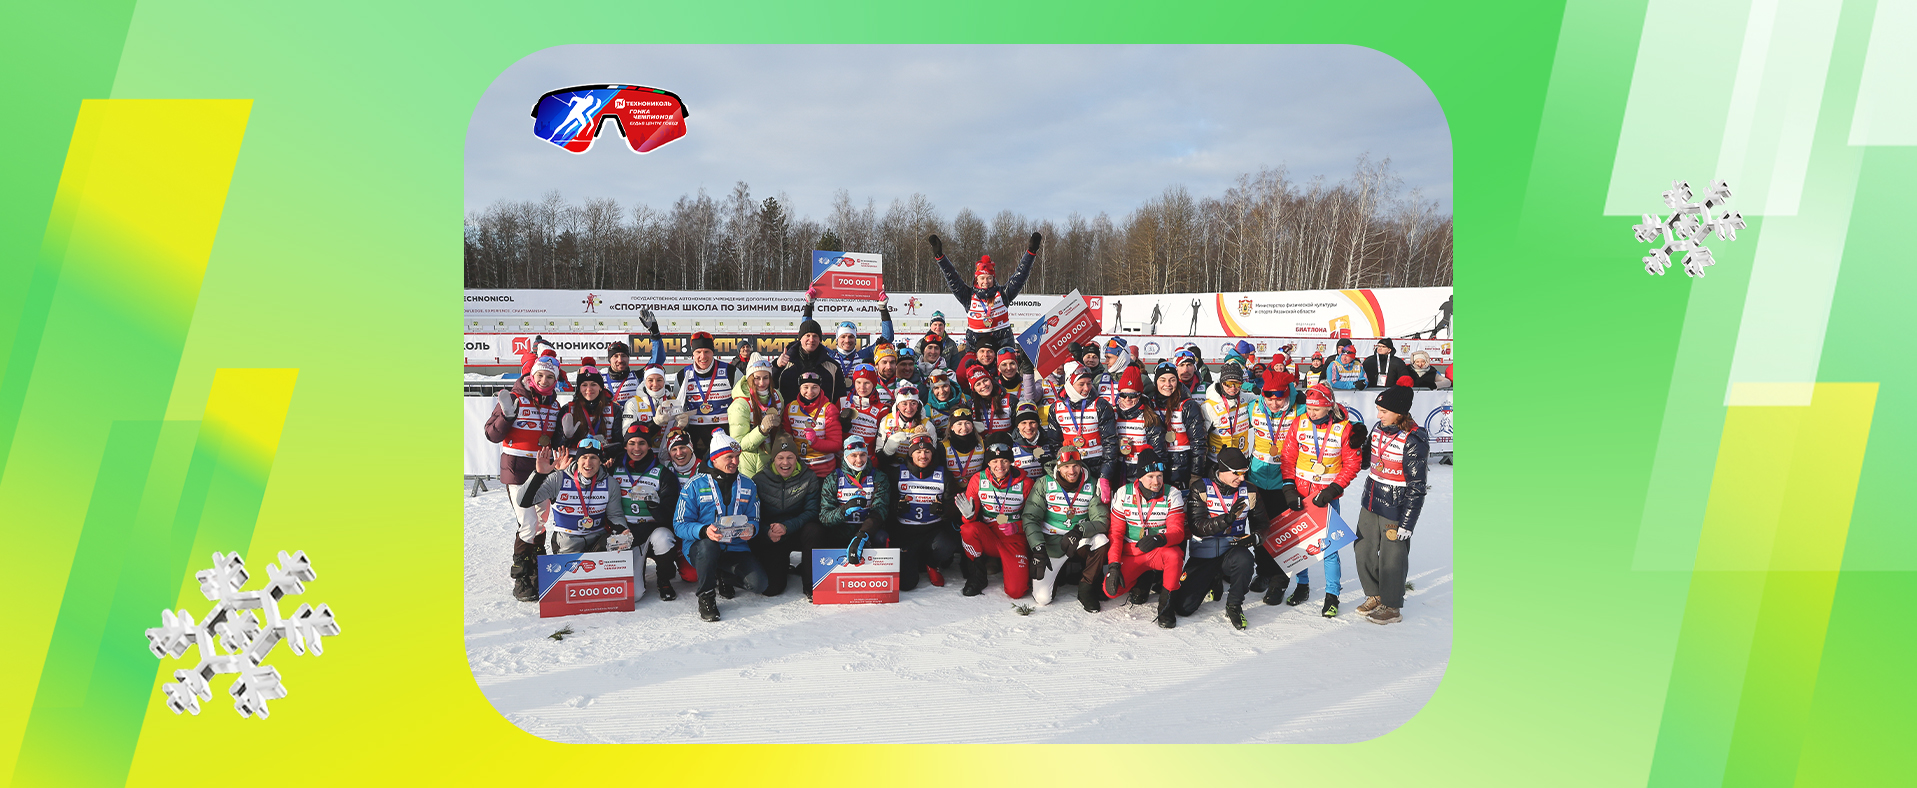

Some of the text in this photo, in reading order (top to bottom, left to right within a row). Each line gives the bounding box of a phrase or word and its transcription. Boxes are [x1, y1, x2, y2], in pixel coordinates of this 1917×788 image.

[1057, 333, 1072, 346] 000
[1072, 321, 1086, 334] 000
[630, 503, 640, 514] 9
[915, 507, 924, 519] 3
[1063, 520, 1072, 528] 4
[1275, 522, 1308, 545] 800 000
[579, 588, 600, 596] 000
[602, 586, 623, 595] 000
